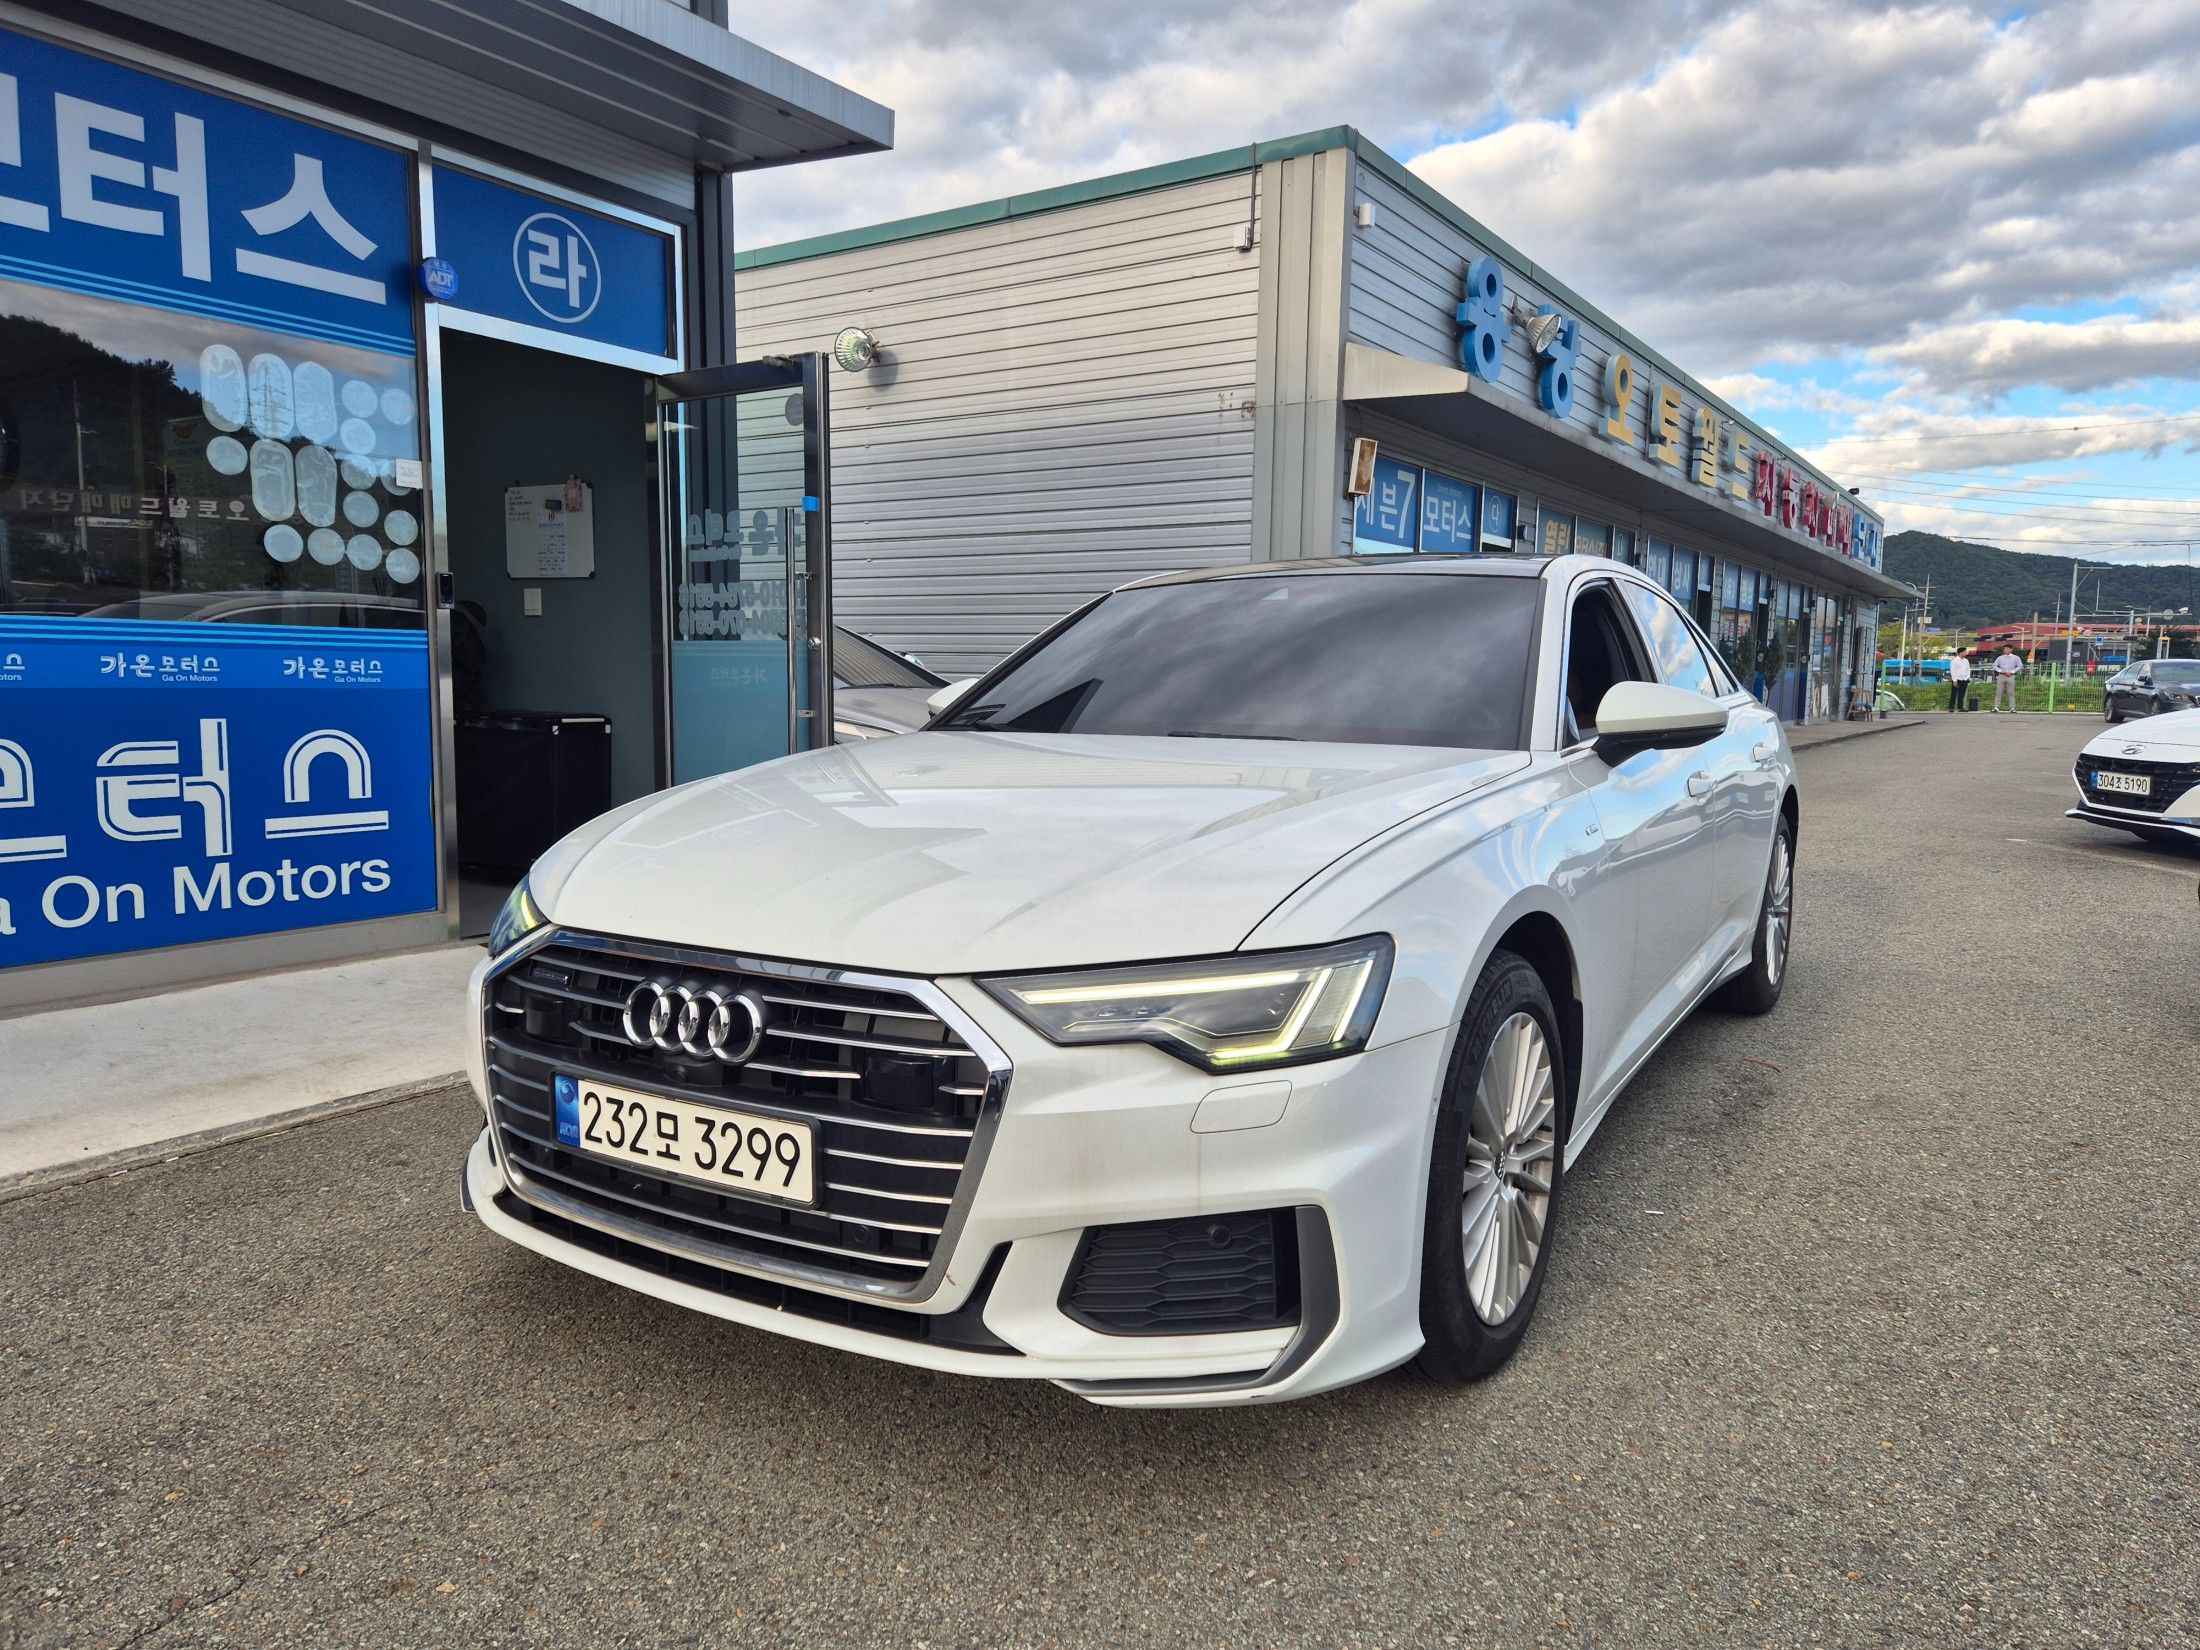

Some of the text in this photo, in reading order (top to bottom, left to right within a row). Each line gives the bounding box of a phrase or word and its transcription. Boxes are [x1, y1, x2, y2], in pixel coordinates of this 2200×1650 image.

[429, 269, 453, 288] ADT
[1424, 495, 1472, 543] 모터스
[162, 674, 218, 682] Ga On Motors
[2098, 774, 2147, 792] 304조 5190
[41, 874, 145, 928] On
[173, 859, 391, 915] Motors
[583, 1091, 801, 1188] 232모 3299
